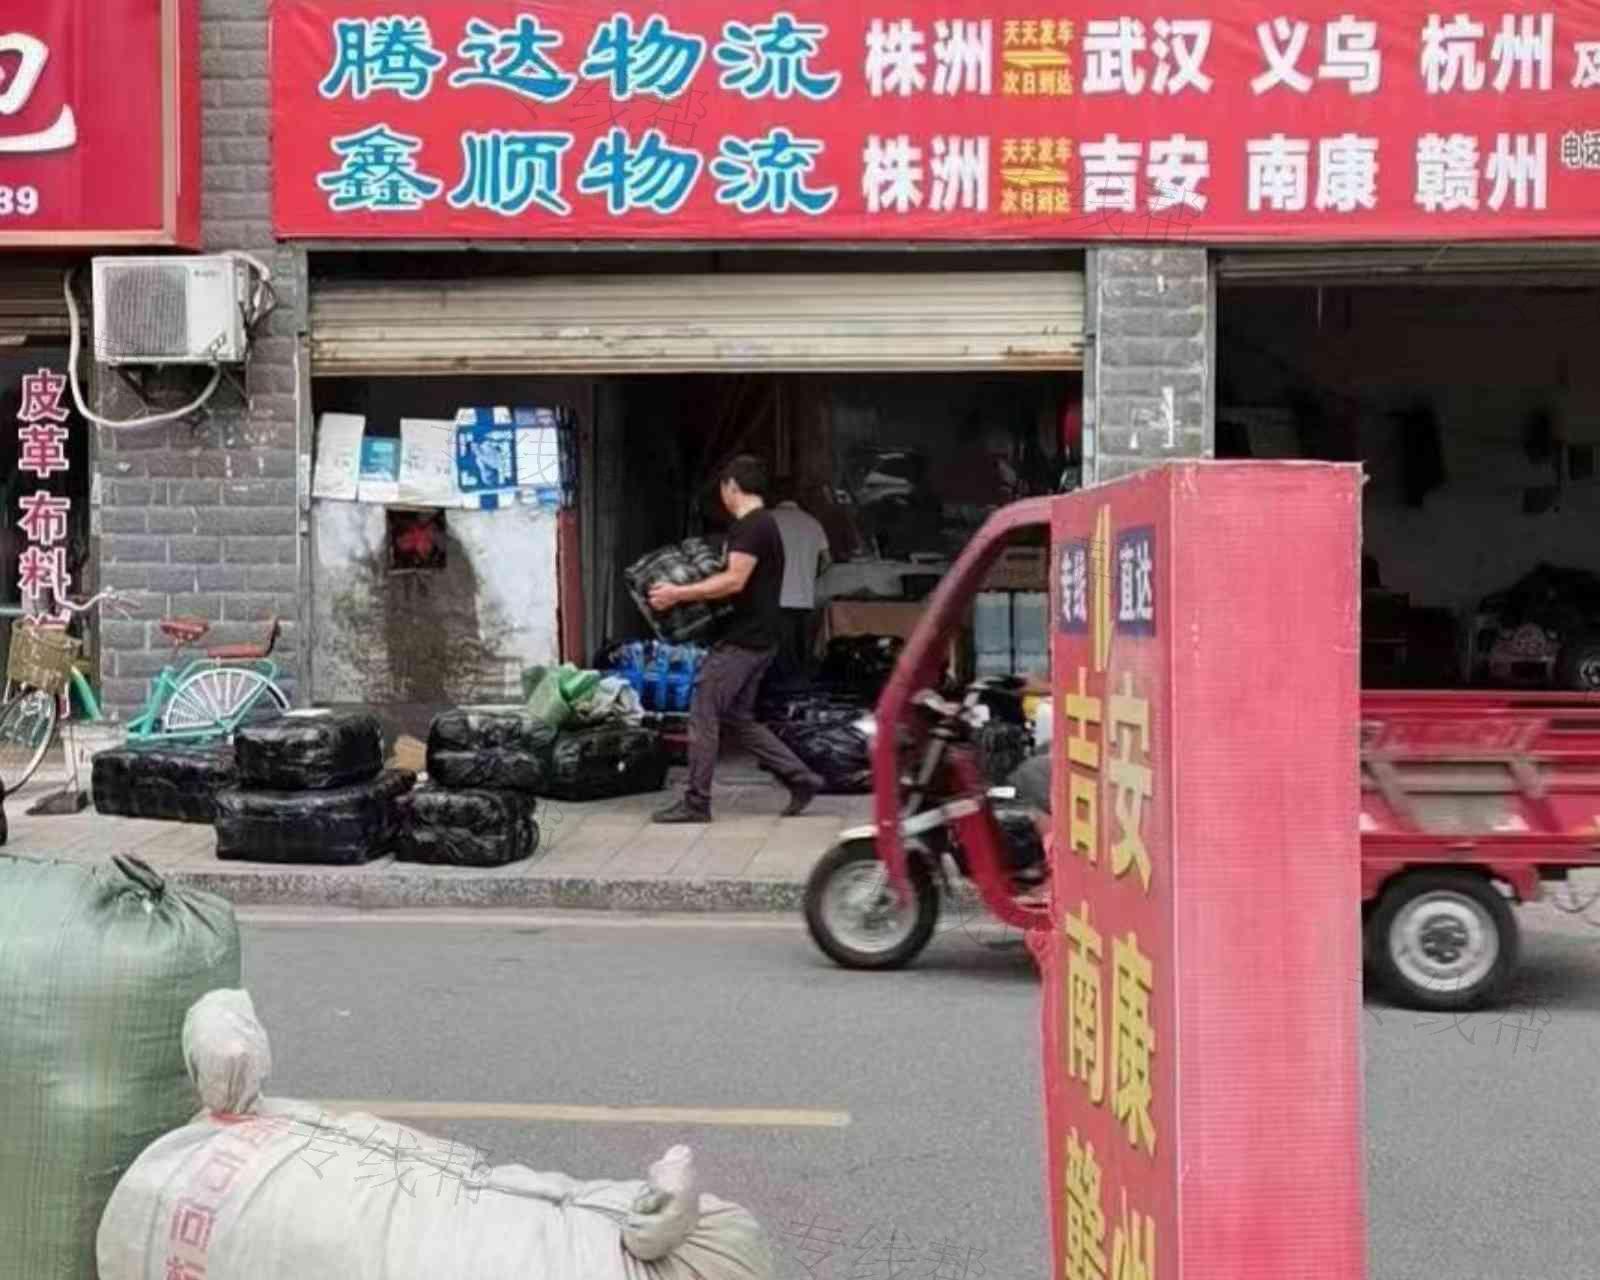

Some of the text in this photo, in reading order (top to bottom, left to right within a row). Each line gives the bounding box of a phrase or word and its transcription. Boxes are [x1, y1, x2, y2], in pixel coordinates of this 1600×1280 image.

[317, 12, 993, 103] 腾达物流 株洲
[1082, 17, 1214, 97] 武汉
[1254, 16, 1382, 96] 义乌
[1421, 13, 1555, 93] 杭州
[316, 125, 990, 217] 鑫顺物流 株洲
[1078, 131, 1549, 214] 吉安 南康 赣州
[17, 368, 71, 479] 皮革
[17, 489, 72, 599] 布料
[1118, 540, 1154, 621] 直达
[1064, 665, 1153, 896] 吉安
[1064, 899, 1156, 1157] 南康
